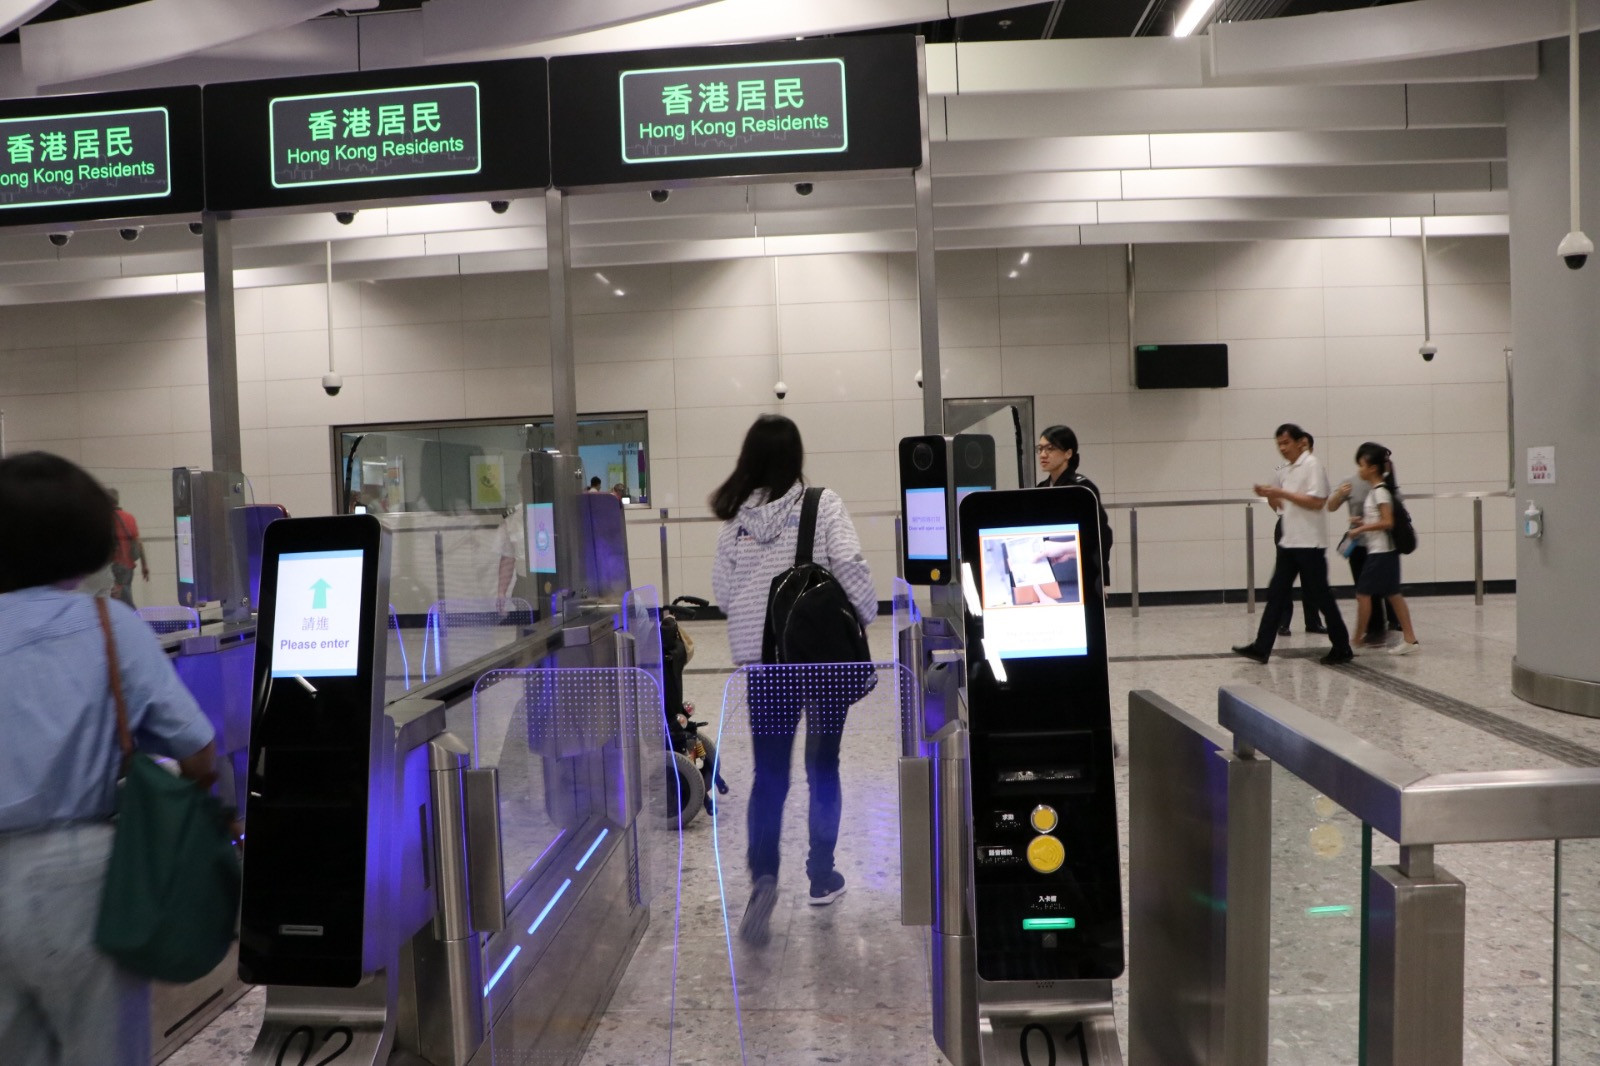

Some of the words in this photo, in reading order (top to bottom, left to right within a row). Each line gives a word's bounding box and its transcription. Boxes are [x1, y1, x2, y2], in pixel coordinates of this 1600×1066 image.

[661, 77, 804, 116] 香港居民
[308, 102, 441, 141] 香港居民
[639, 123, 686, 141] Hong
[691, 120, 736, 138] Kong
[742, 114, 829, 133] Residents
[7, 126, 134, 165] 香港居民
[287, 148, 330, 166] Hong
[335, 145, 377, 162] Kong
[382, 137, 464, 157] Residents
[0, 173, 29, 188] ong
[33, 168, 74, 185] Kong
[78, 161, 155, 180] Residents
[301, 616, 329, 631] 請進
[280, 639, 317, 650] Please
[320, 638, 350, 649] enter
[1019, 1021, 1090, 1066] 01
